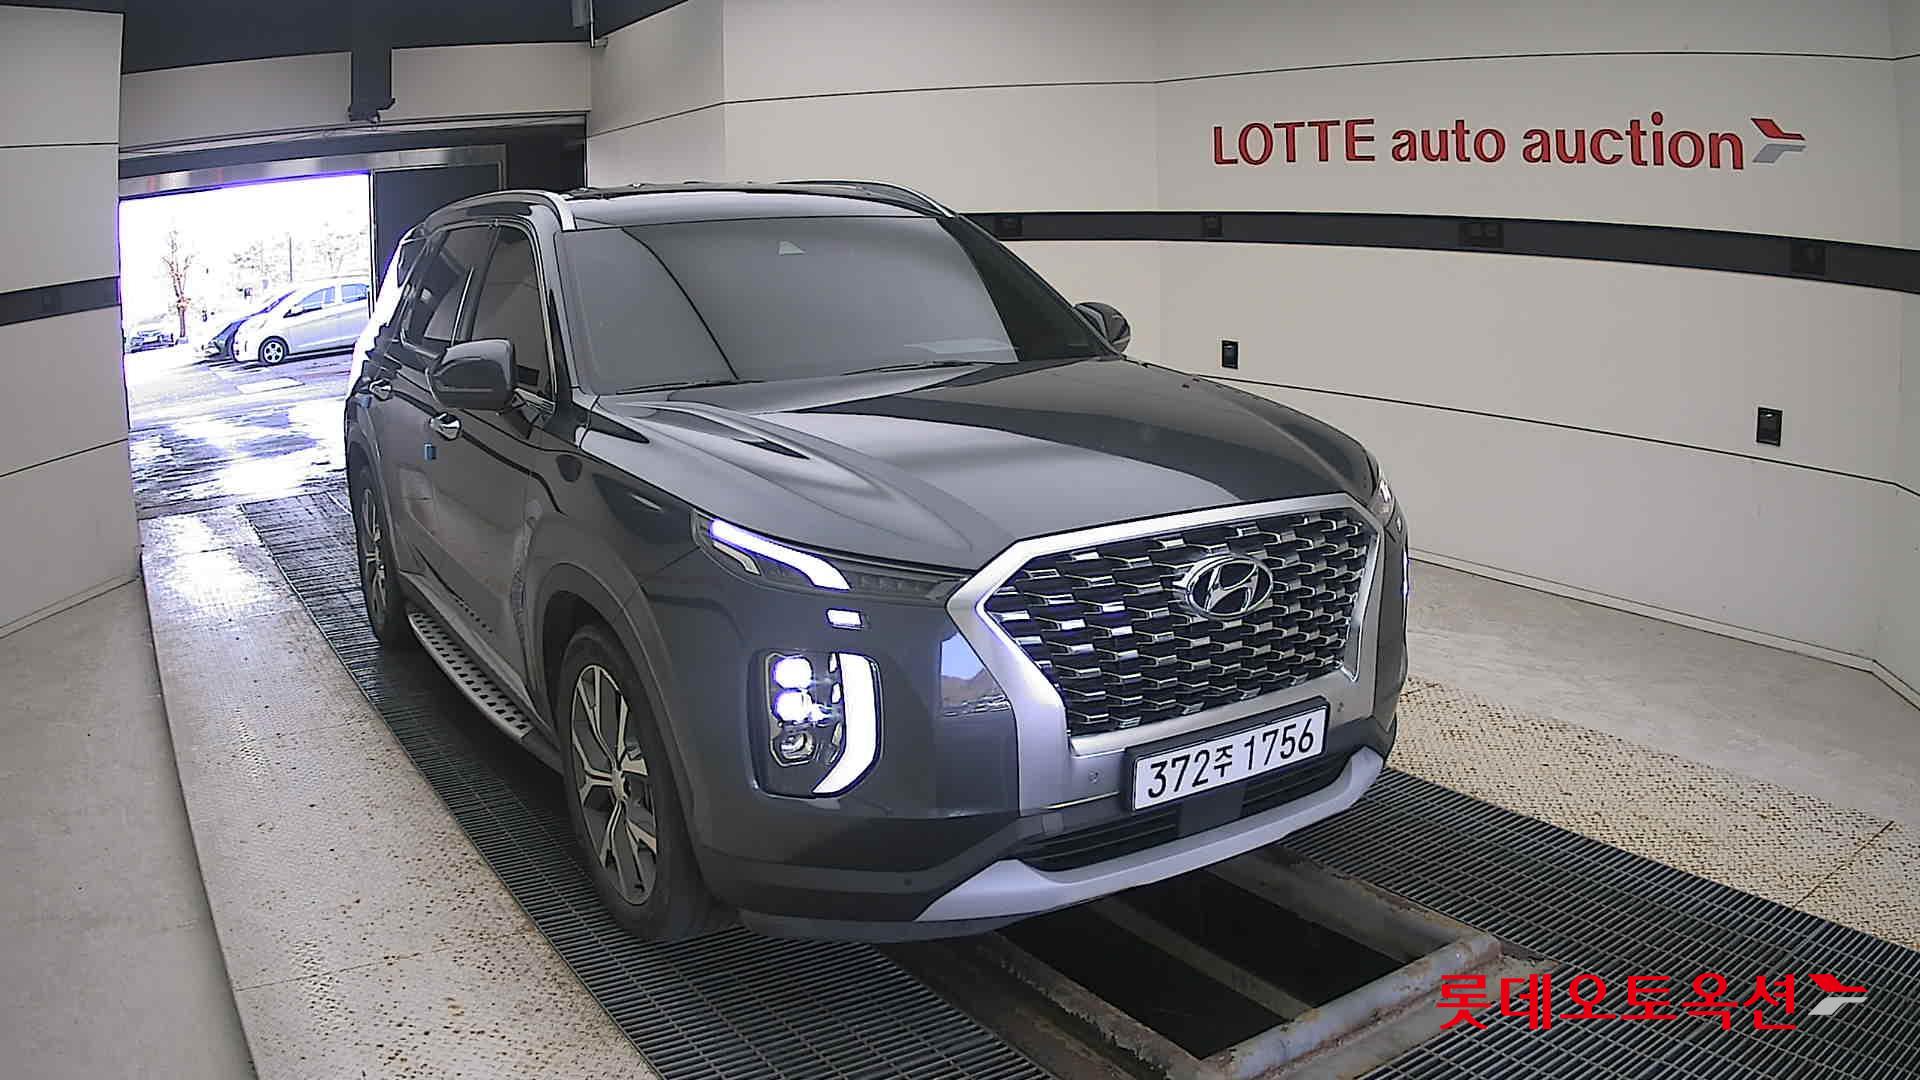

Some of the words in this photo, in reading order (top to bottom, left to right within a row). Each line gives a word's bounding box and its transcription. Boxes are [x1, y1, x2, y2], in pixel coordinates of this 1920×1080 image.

[1213, 118, 1376, 166] LOTTE
[1391, 119, 1506, 163] auto
[1522, 111, 1746, 171] auction
[1147, 743, 1234, 799] 372주
[1243, 717, 1315, 771] 1756
